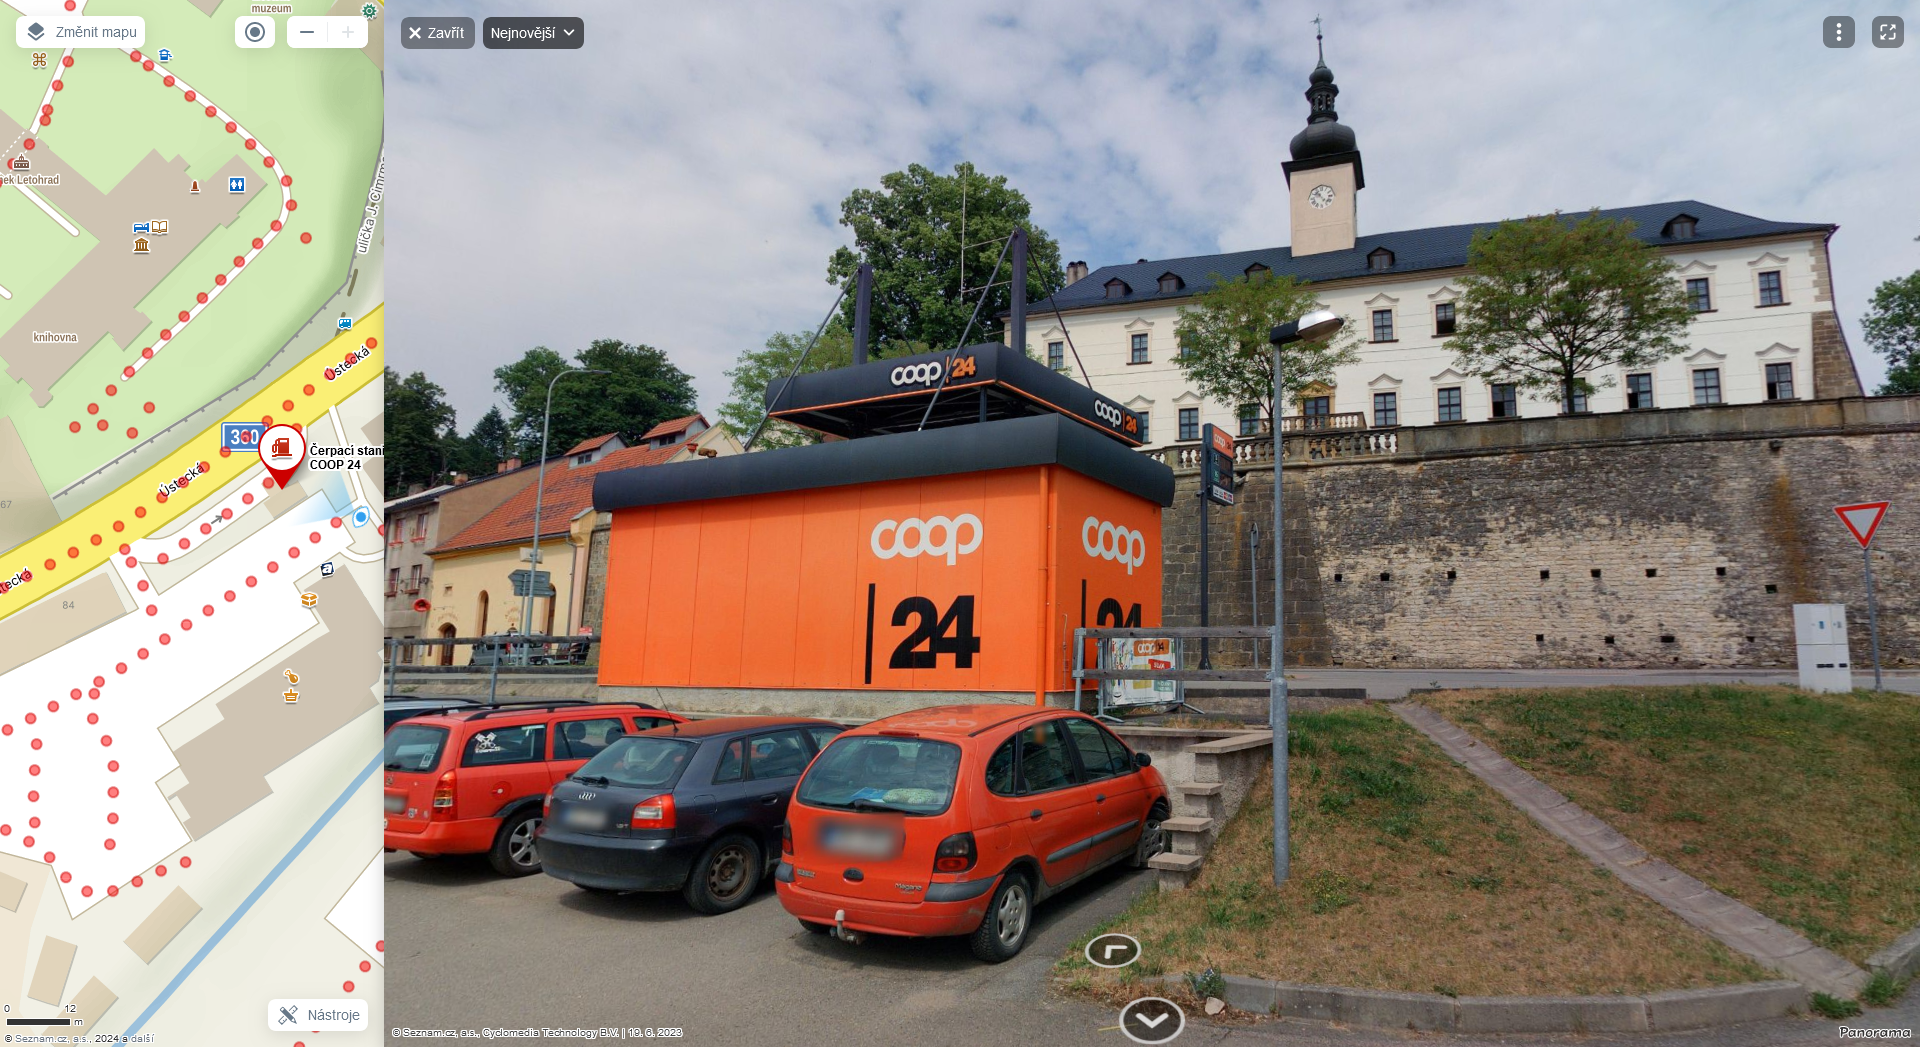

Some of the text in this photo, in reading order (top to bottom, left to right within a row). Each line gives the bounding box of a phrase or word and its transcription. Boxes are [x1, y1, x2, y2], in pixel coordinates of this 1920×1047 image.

[890, 355, 977, 387] coop 24
[1093, 398, 1138, 435] coop 24
[870, 512, 984, 567] coop
[1081, 515, 1147, 576] coop
[889, 594, 981, 670] 24
